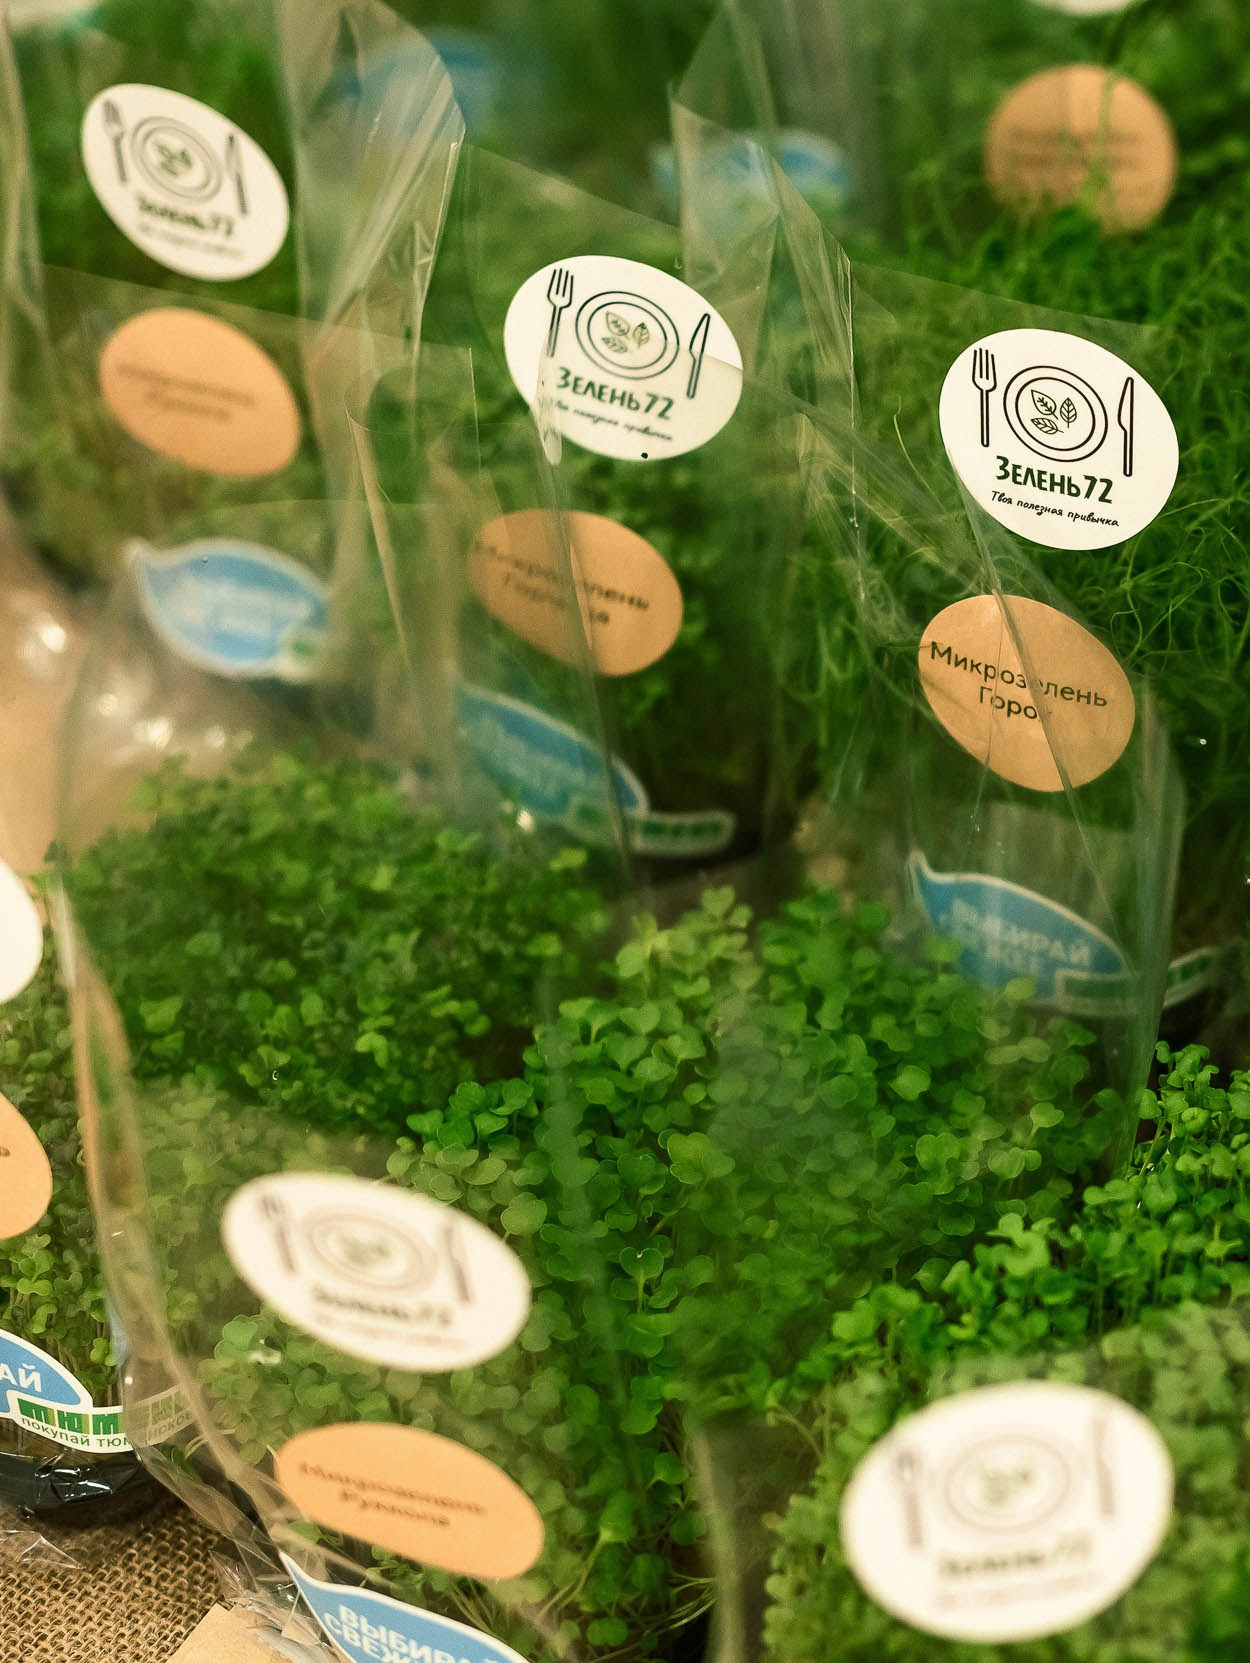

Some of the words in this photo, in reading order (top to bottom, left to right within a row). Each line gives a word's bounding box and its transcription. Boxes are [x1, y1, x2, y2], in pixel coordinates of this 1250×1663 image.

[991, 490, 1013, 505] Твоя
[1017, 499, 1063, 516] полезная
[1067, 510, 1120, 527] привычка
[930, 641, 1108, 708] Микрозлень
[979, 685, 1053, 720] Горо
[21, 1417, 91, 1447] покупай
